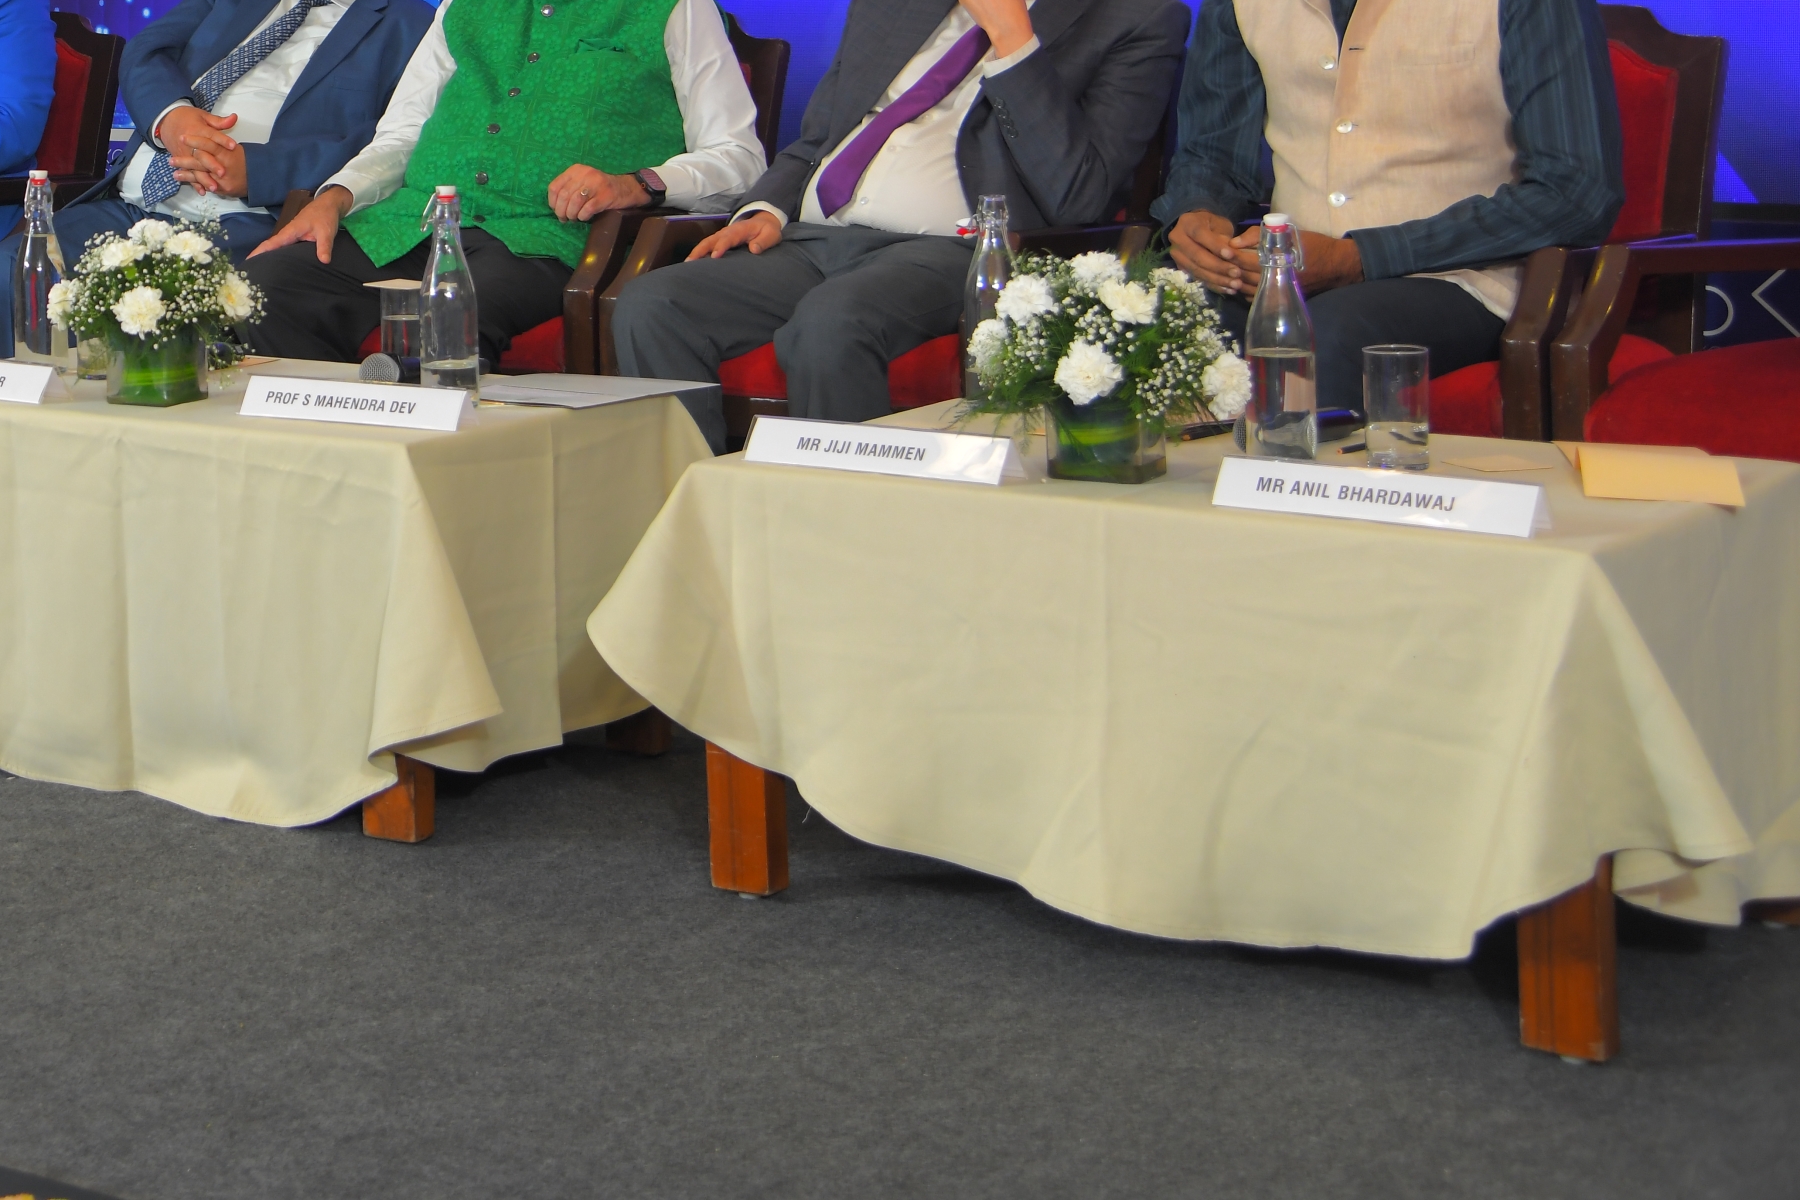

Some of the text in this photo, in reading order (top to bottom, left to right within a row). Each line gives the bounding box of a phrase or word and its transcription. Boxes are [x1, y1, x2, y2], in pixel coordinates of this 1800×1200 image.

[265, 390, 417, 414] PROF S MAHENDRA DEV
[796, 436, 926, 461] MR JIJI MAMMEN
[1256, 476, 1456, 512] MR ANIL BHARDAWAJ
